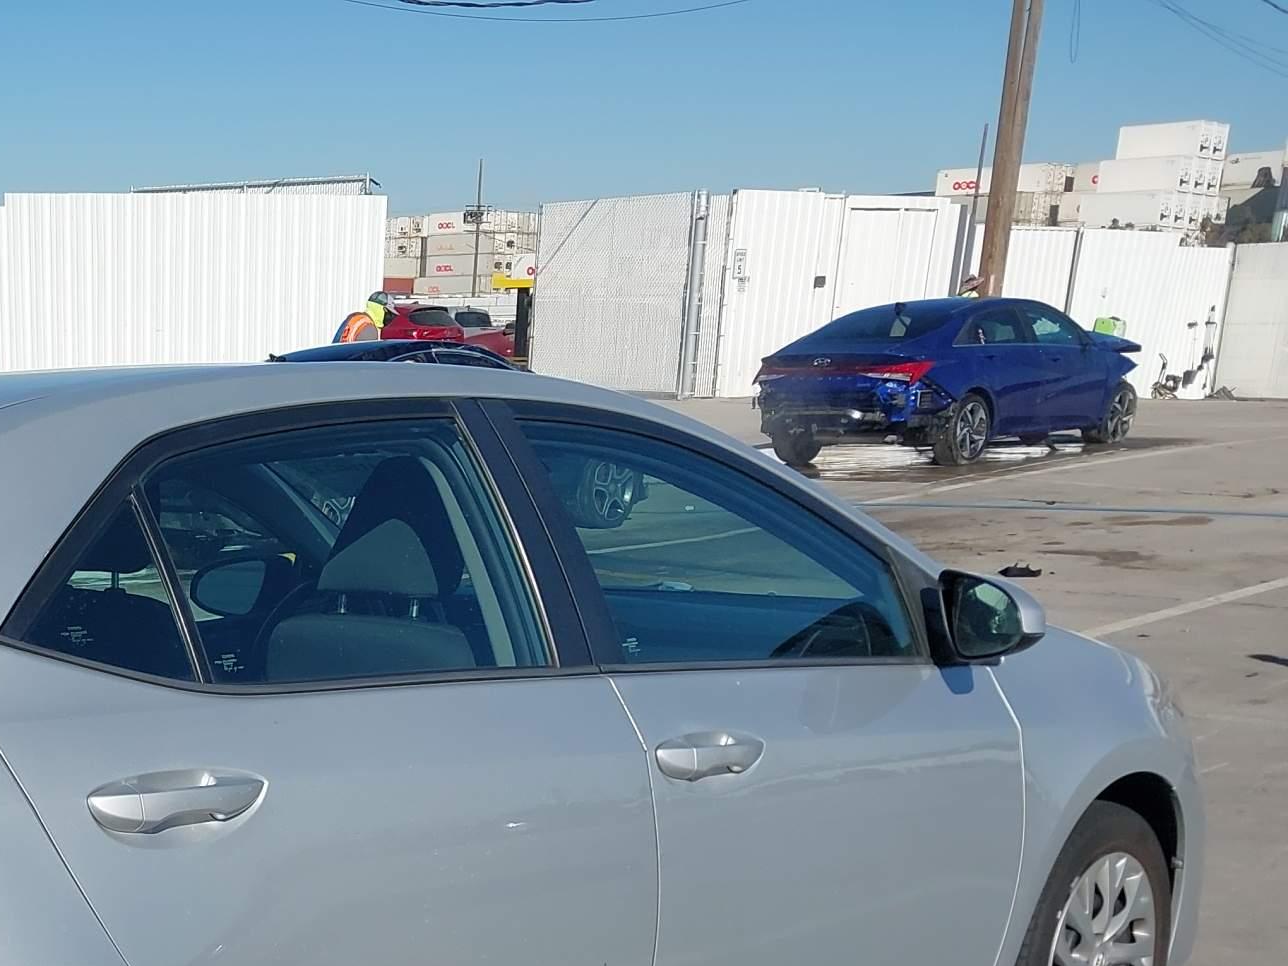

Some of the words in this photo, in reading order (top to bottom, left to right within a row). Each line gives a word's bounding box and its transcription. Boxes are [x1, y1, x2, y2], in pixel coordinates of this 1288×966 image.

[953, 181, 981, 190] OOC
[438, 222, 455, 230] OOCL
[436, 265, 453, 273] OOCL
